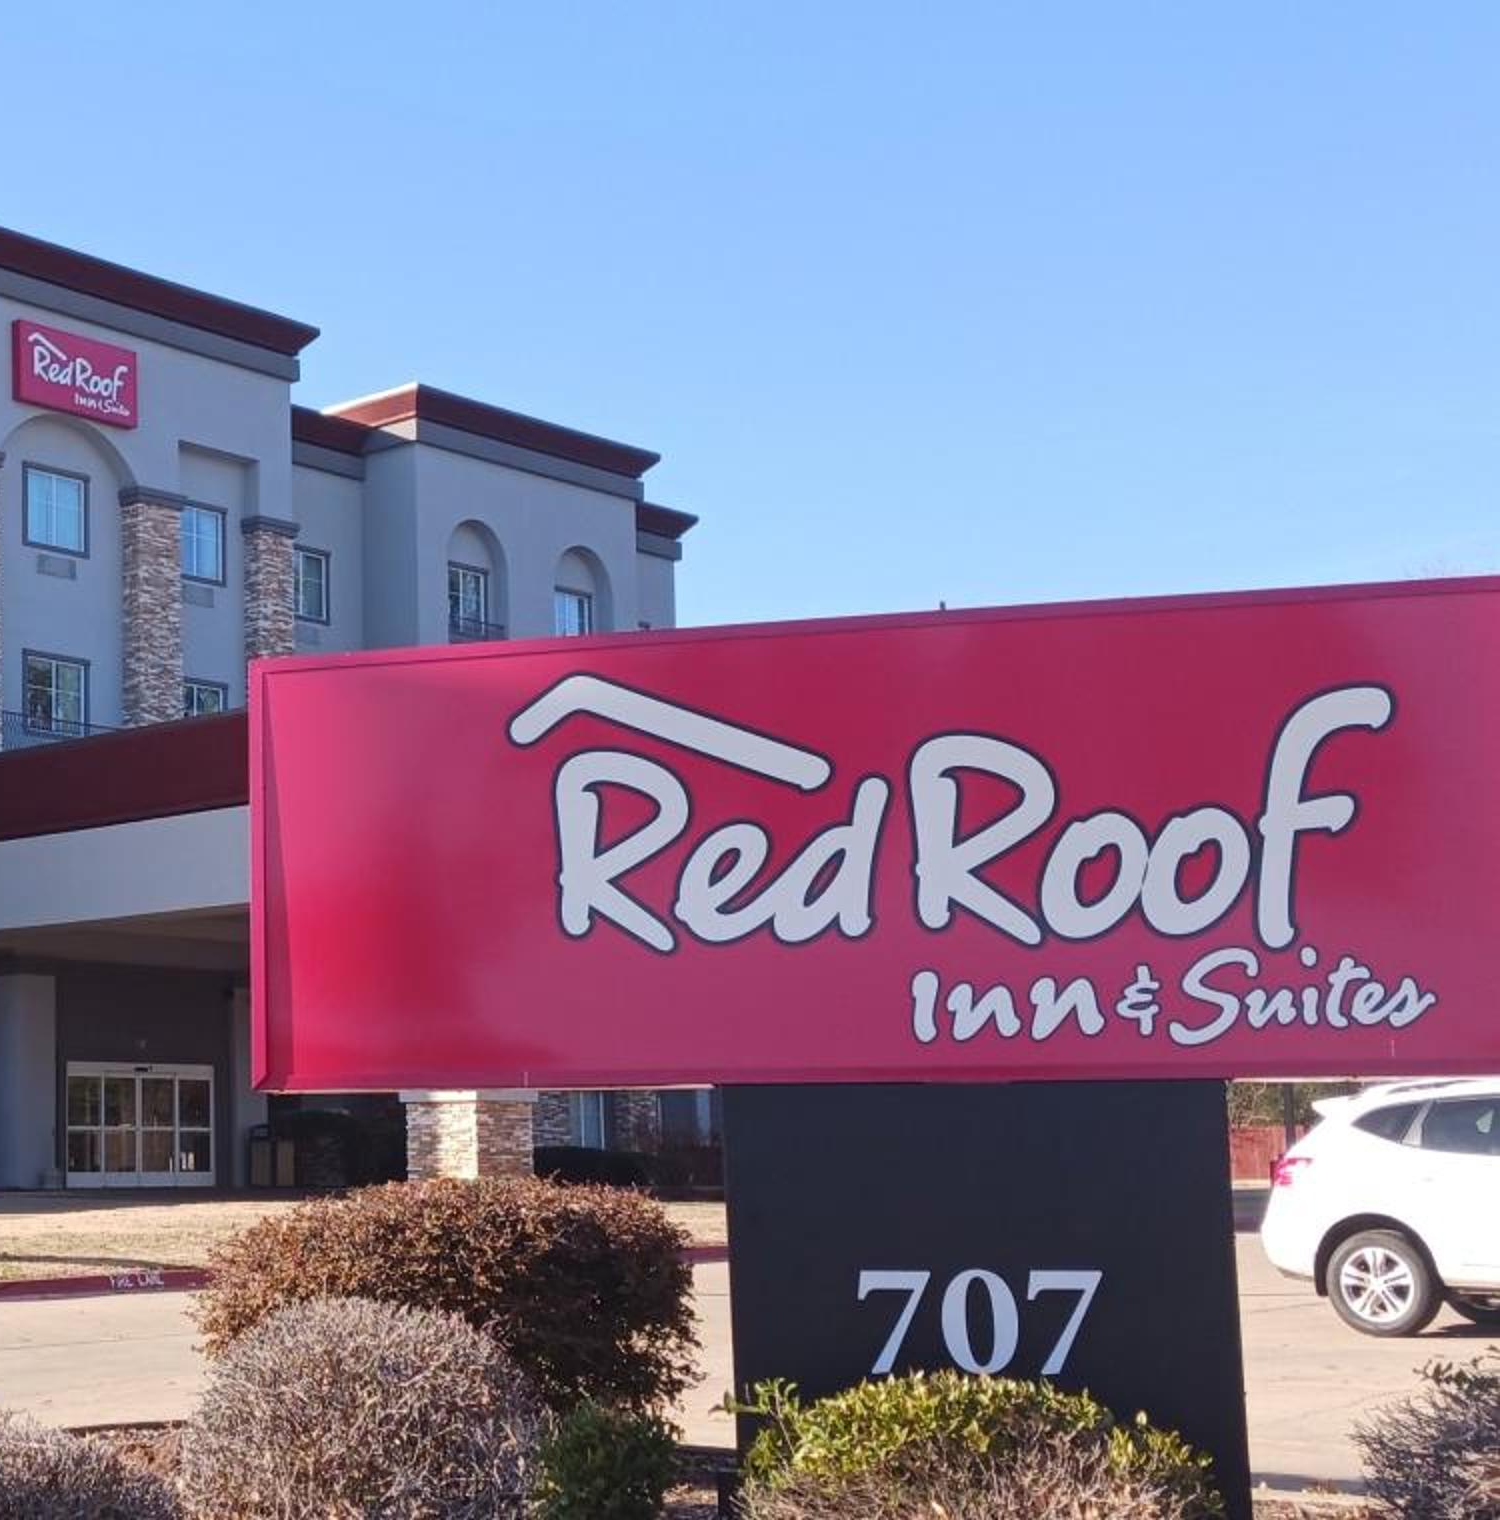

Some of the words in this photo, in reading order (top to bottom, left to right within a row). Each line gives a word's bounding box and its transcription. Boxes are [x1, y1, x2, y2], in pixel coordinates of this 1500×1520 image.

[554, 749, 890, 952] Red
[908, 686, 1393, 949] Roof
[911, 970, 1105, 1043] Inn
[1116, 964, 1160, 1036] &
[1168, 945, 1436, 1046] Suites
[857, 1268, 1103, 1376] 707
